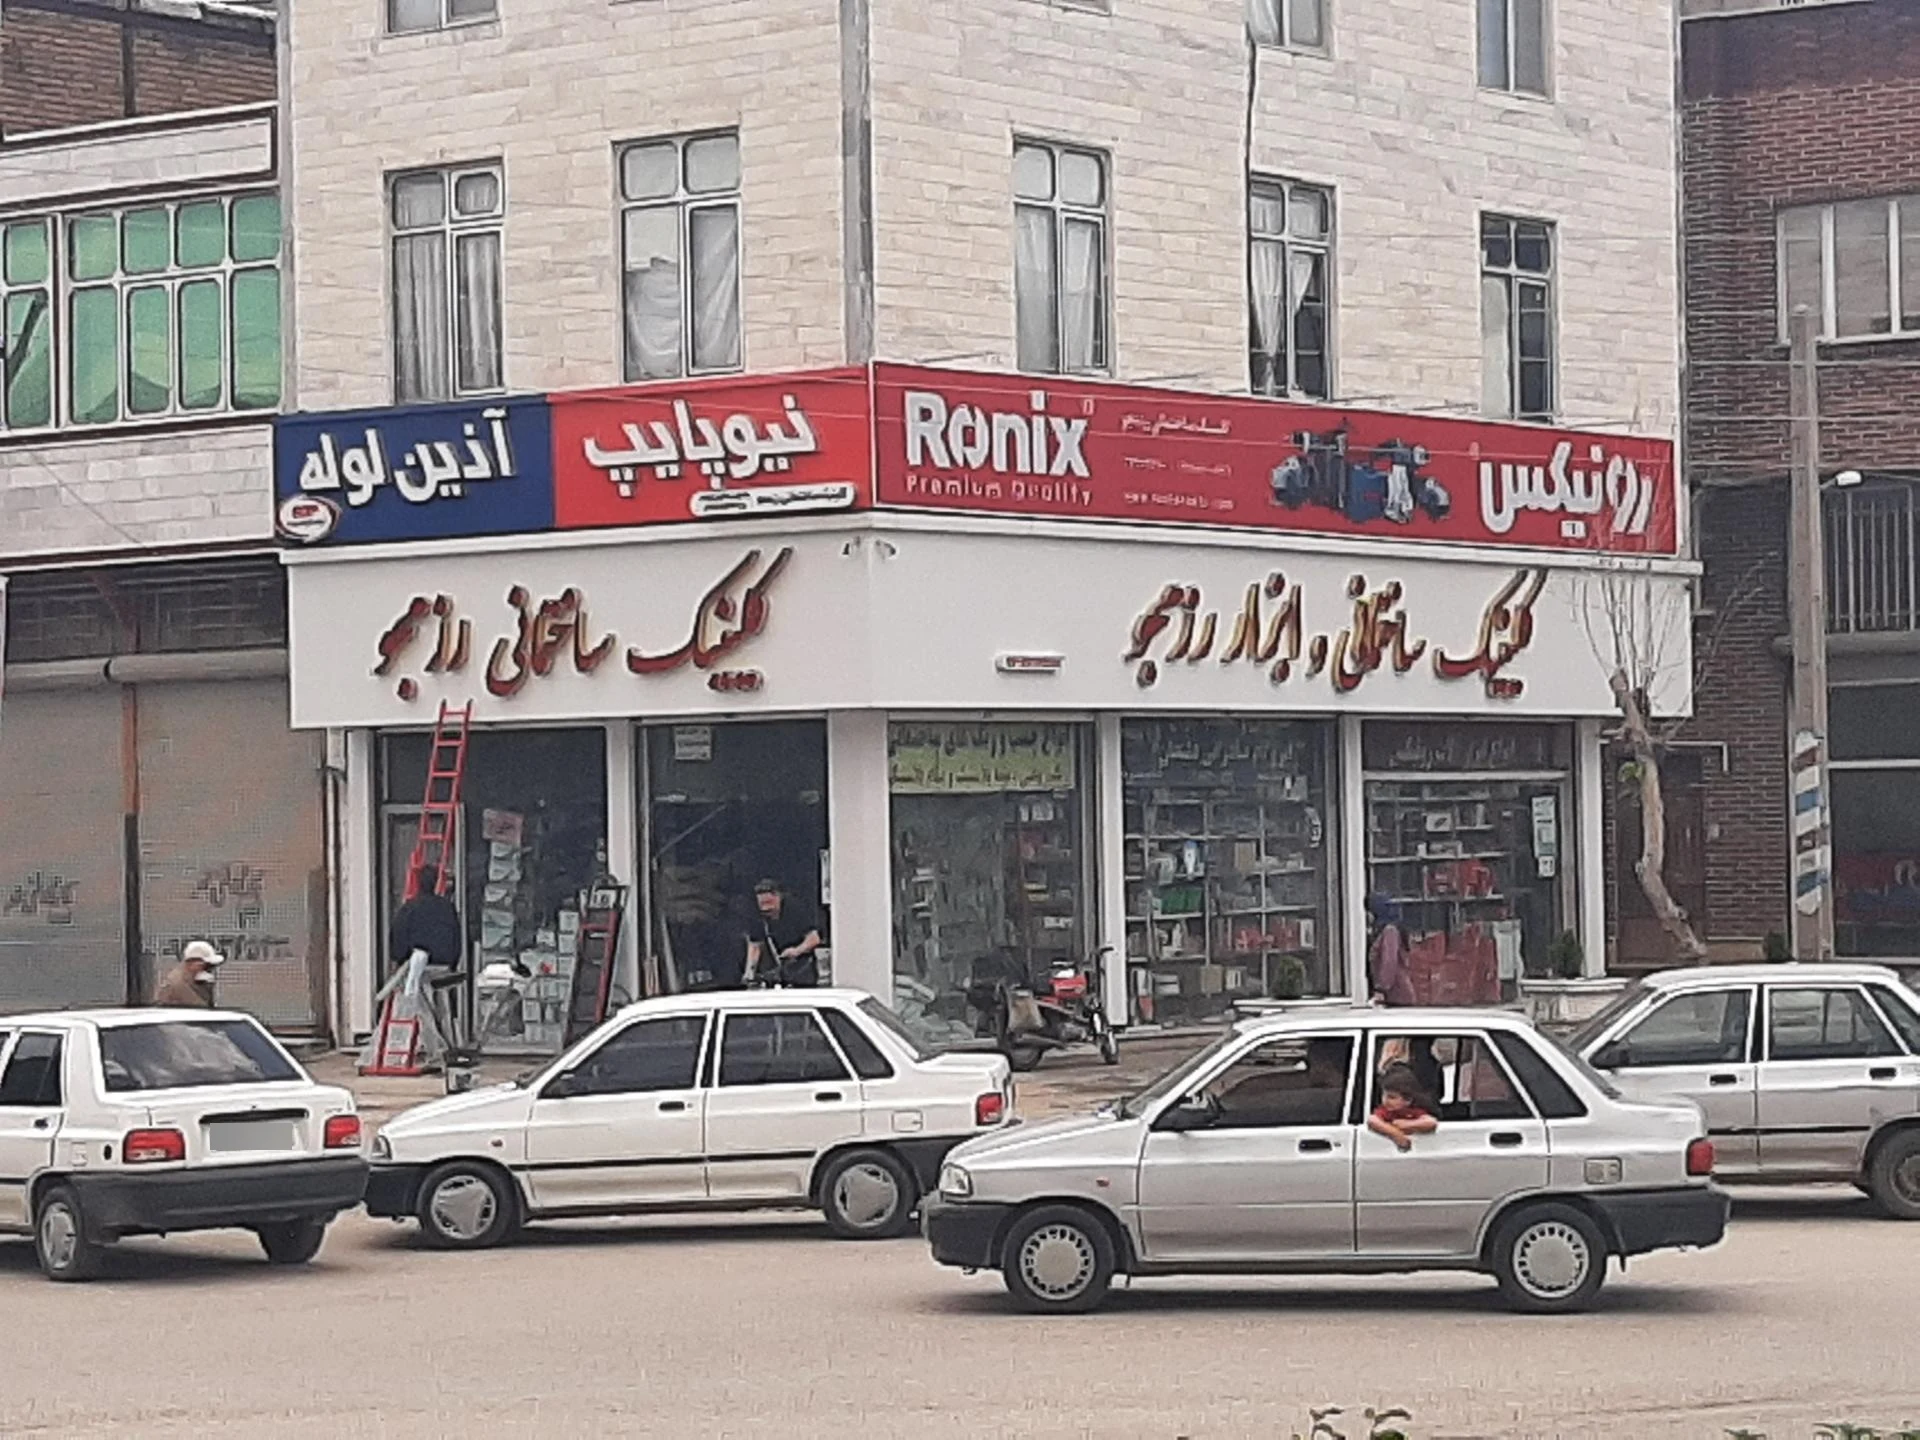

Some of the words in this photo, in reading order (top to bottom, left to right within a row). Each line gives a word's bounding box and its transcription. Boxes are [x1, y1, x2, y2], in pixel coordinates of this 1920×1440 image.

[299, 427, 386, 505] لوله
[393, 407, 512, 502] آذین
[904, 390, 1090, 477] Ronix
[907, 474, 1001, 499] Premium
[1011, 479, 1091, 506] Quality
[1480, 441, 1652, 538] رونیکس
[371, 594, 472, 700] رزمجو
[485, 584, 615, 697] ساختمانی
[1121, 584, 1218, 689] رزمجو
[1219, 572, 1302, 685] ابزار
[1304, 634, 1328, 678] و
[1331, 574, 1427, 693] ساختمانی
